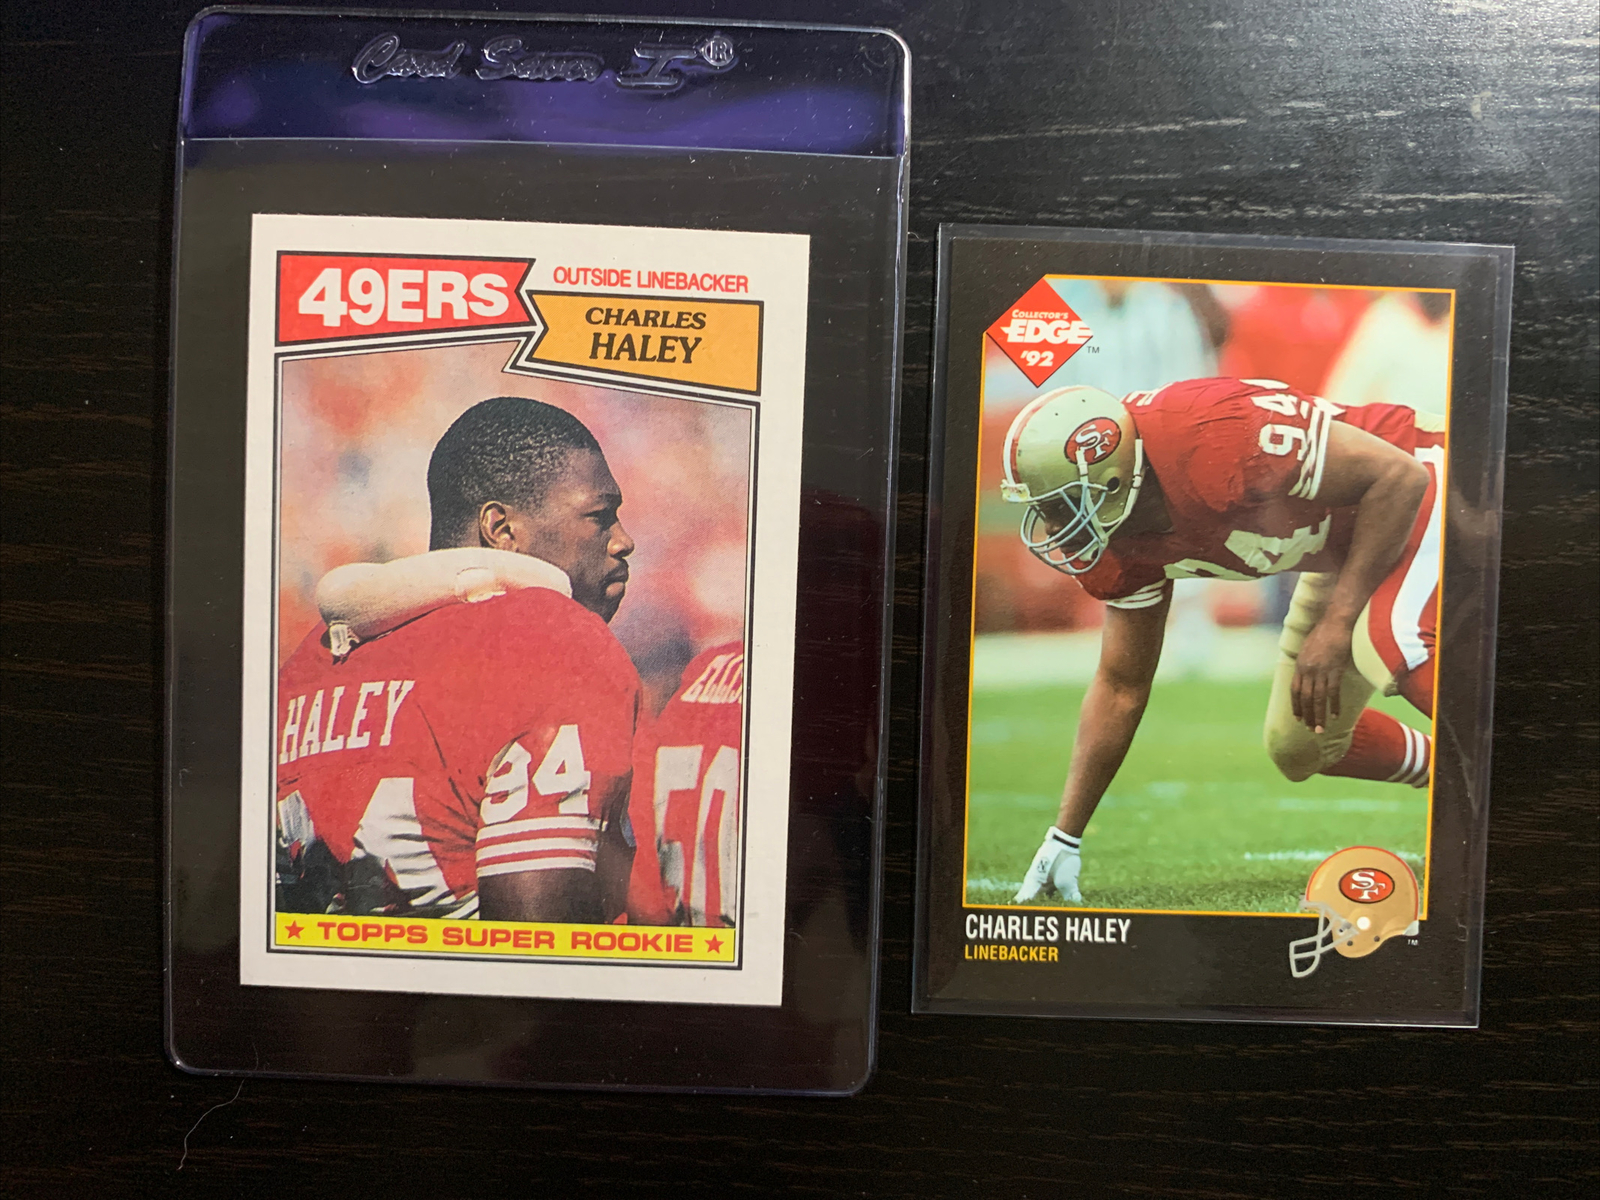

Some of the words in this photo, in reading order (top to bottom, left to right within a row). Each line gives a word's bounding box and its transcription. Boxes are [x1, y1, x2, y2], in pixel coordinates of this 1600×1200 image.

[553, 266, 632, 289] OUTSIDE
[636, 271, 749, 293] LINEBACKER
[299, 267, 510, 327] 49ERS
[585, 307, 707, 331] CHARLES
[1000, 319, 1094, 345] EDGE
[589, 333, 703, 364] HALEY
[1020, 351, 1055, 367] '92
[278, 680, 416, 765] HALEY
[480, 724, 592, 826] 94
[317, 922, 429, 943] TOPPS
[442, 928, 555, 949] SUPER
[571, 932, 694, 953] ROOKIE
[965, 913, 1059, 942] CHARLES
[1065, 918, 1132, 943] HALEY
[964, 943, 1060, 963] LINEBACKER
